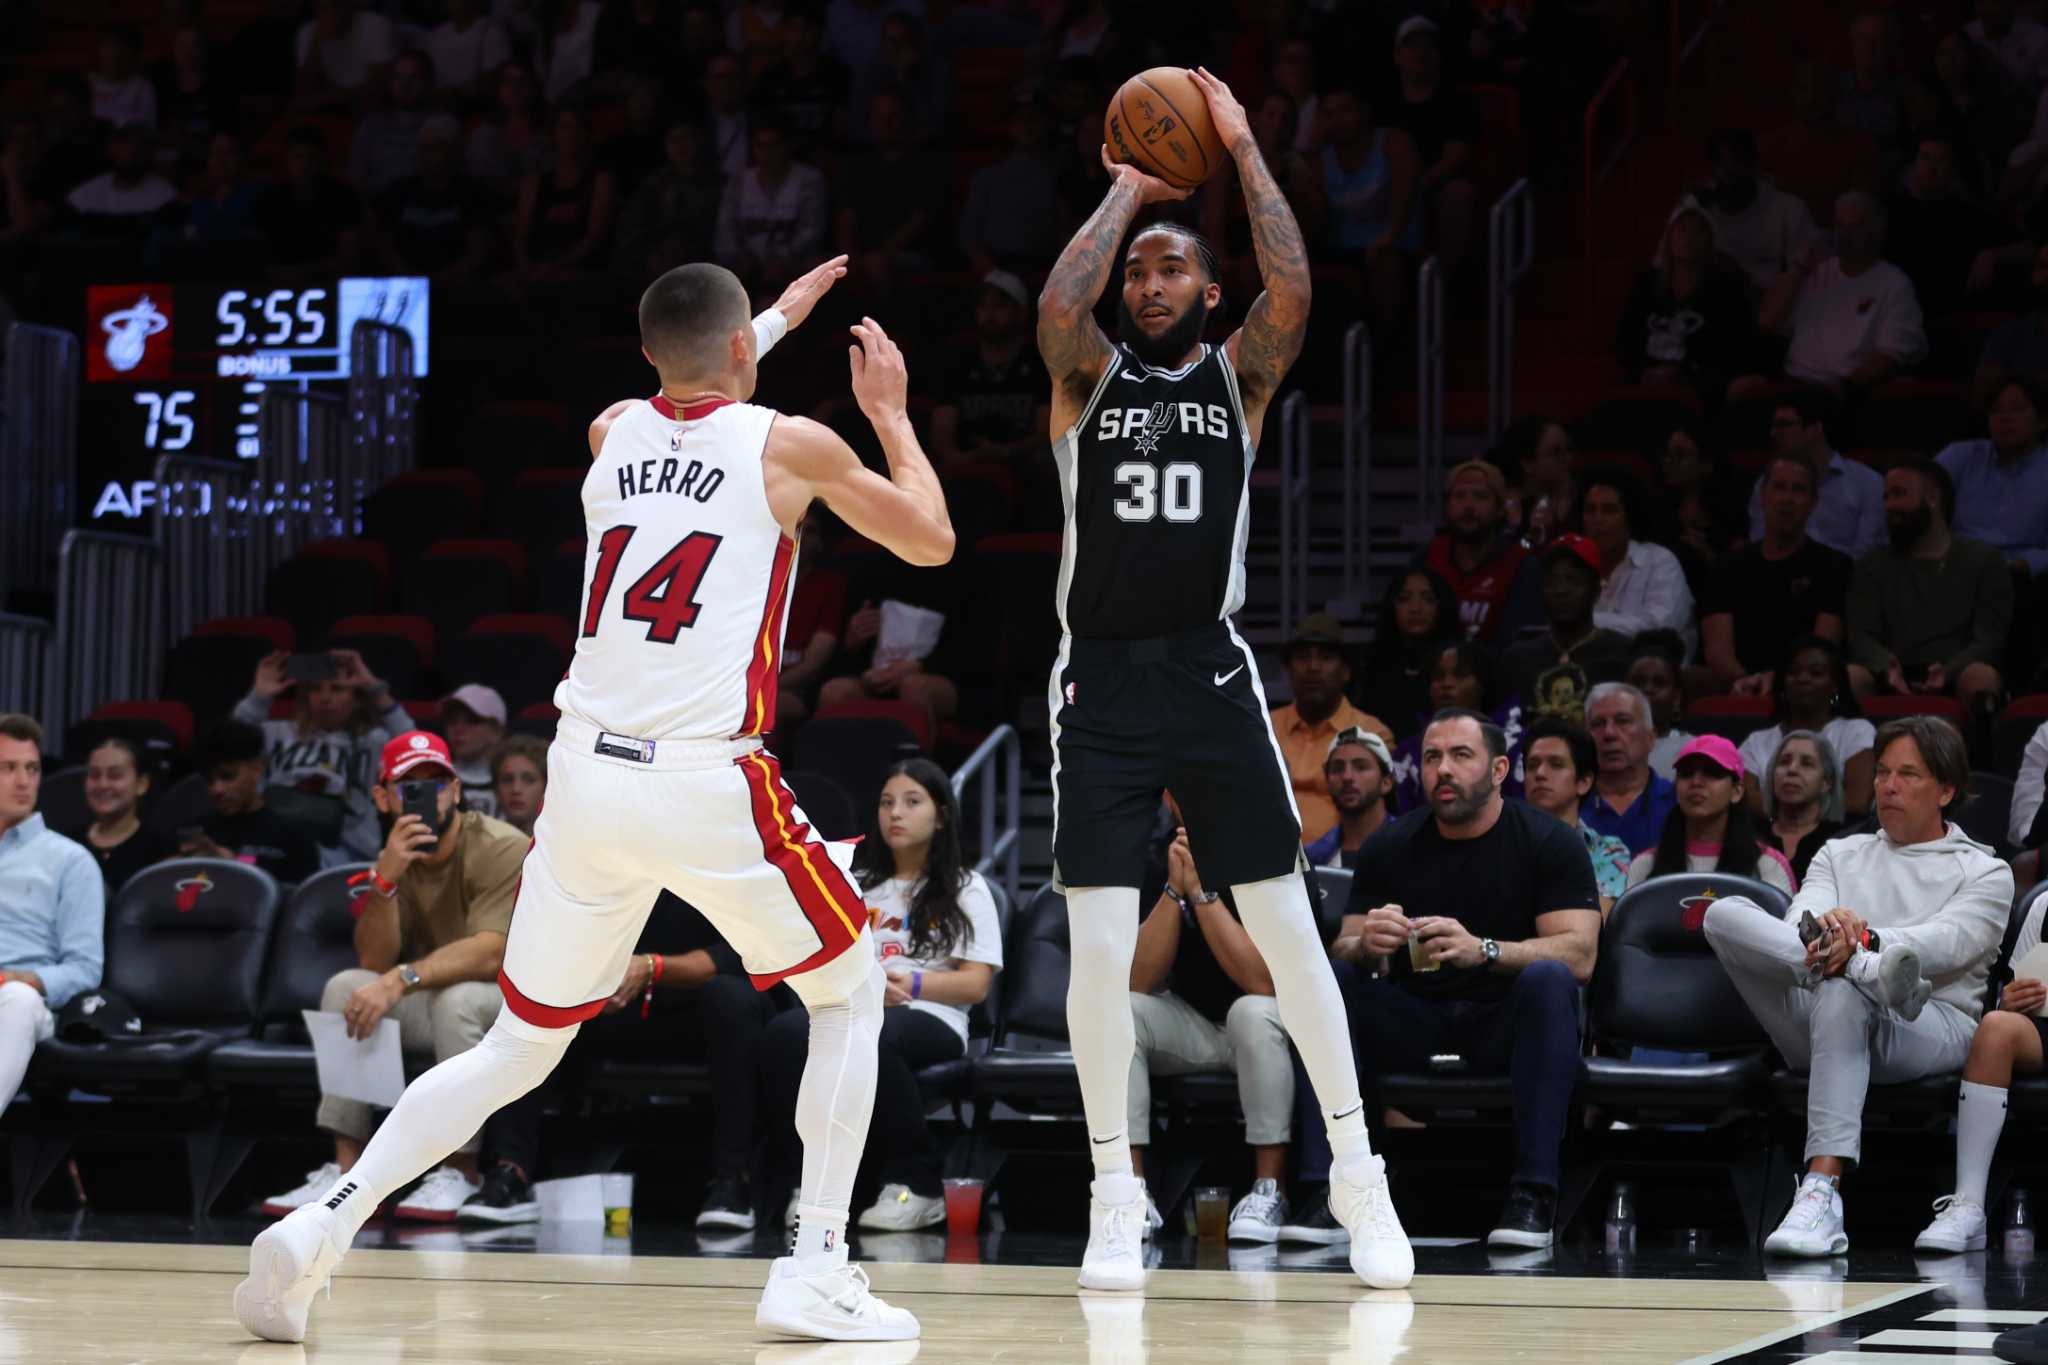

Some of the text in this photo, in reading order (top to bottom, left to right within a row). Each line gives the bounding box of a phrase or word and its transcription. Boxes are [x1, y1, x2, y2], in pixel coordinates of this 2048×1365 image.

[216, 289, 325, 346] 5:55
[218, 355, 291, 376] BONUS
[135, 391, 195, 449] 75
[1098, 402, 1229, 446] SPURS
[617, 458, 725, 503] HERRO
[1114, 461, 1203, 523] 30
[582, 524, 723, 645] 14
